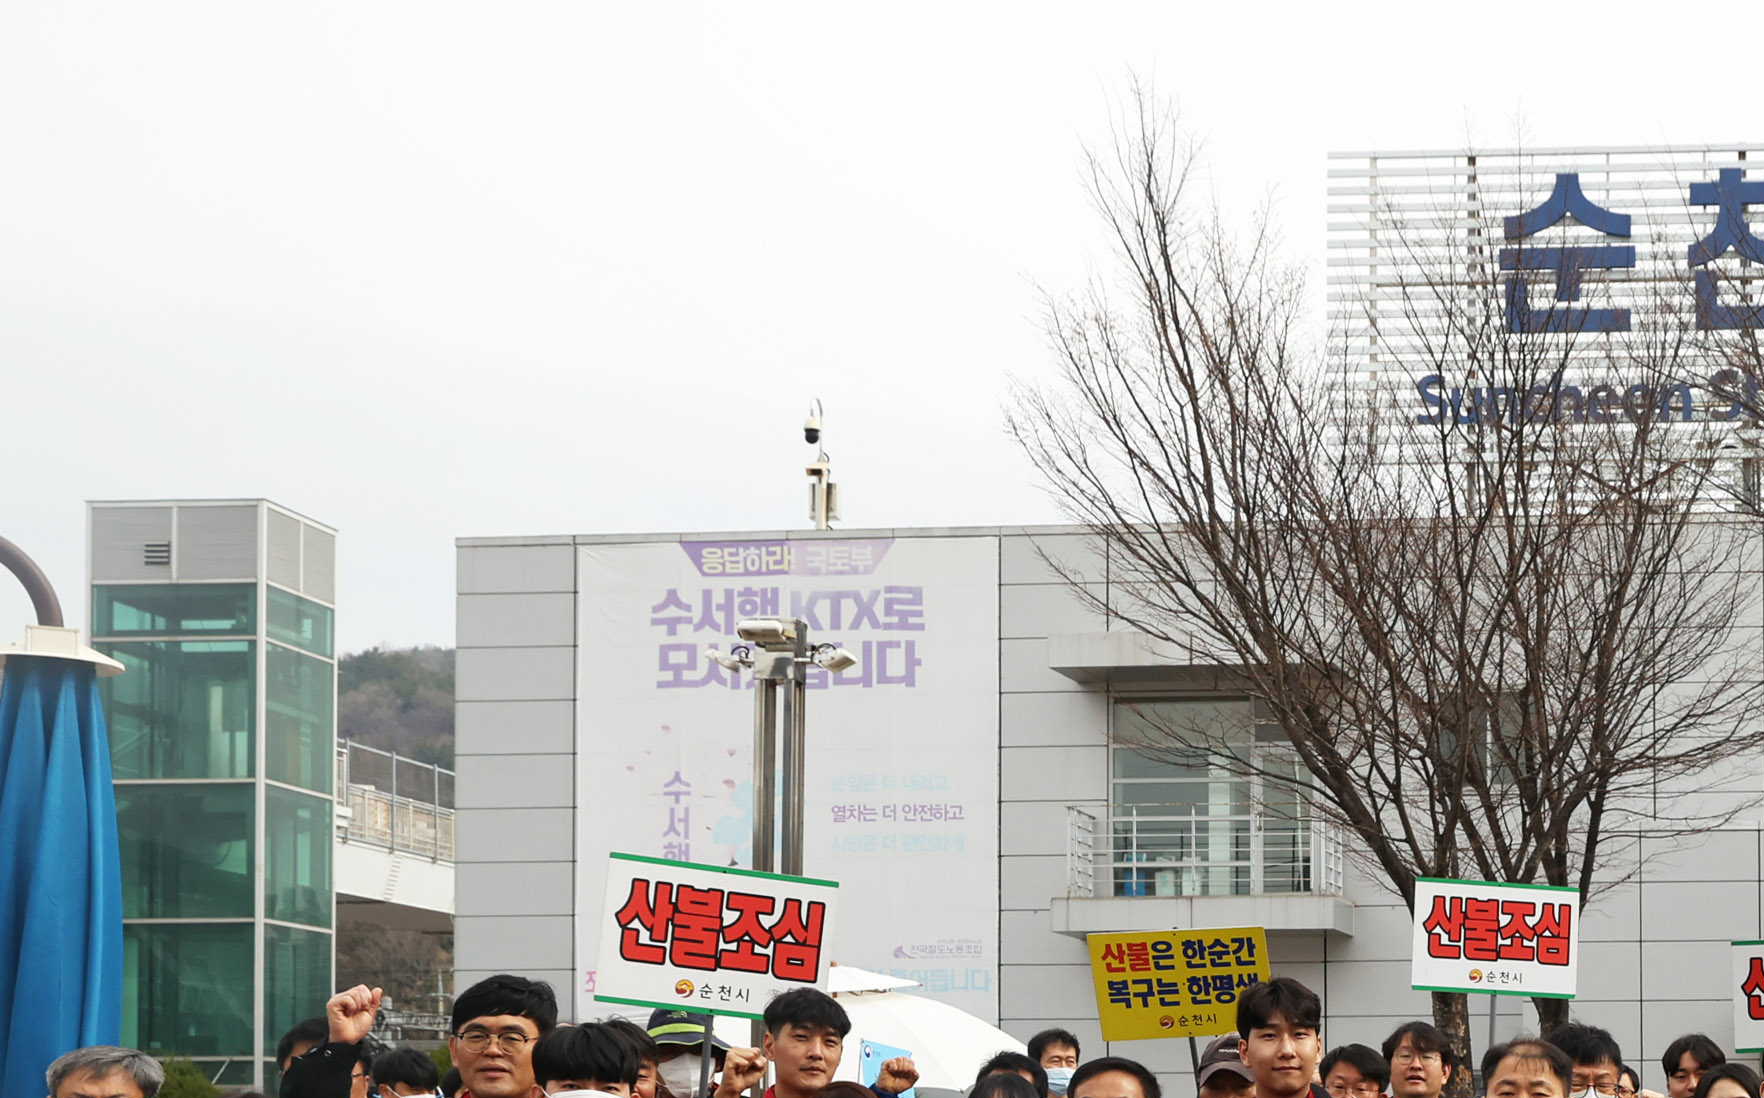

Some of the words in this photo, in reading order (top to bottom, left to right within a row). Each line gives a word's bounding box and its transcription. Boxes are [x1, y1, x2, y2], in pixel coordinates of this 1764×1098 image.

[805, 544, 875, 574] 국토부
[830, 803, 878, 823] 열차는
[882, 803, 897, 823] 더
[901, 803, 966, 823] 안전하고
[614, 877, 826, 985] 산불조심
[1424, 896, 1571, 967] 산불조심
[1101, 940, 1176, 974] 산불은
[1181, 937, 1257, 969] 한순간
[1485, 970, 1523, 985] 순천시
[697, 983, 751, 1004] 순천시
[1107, 977, 1181, 1010] 복구는
[1177, 1012, 1218, 1028] 순천시
